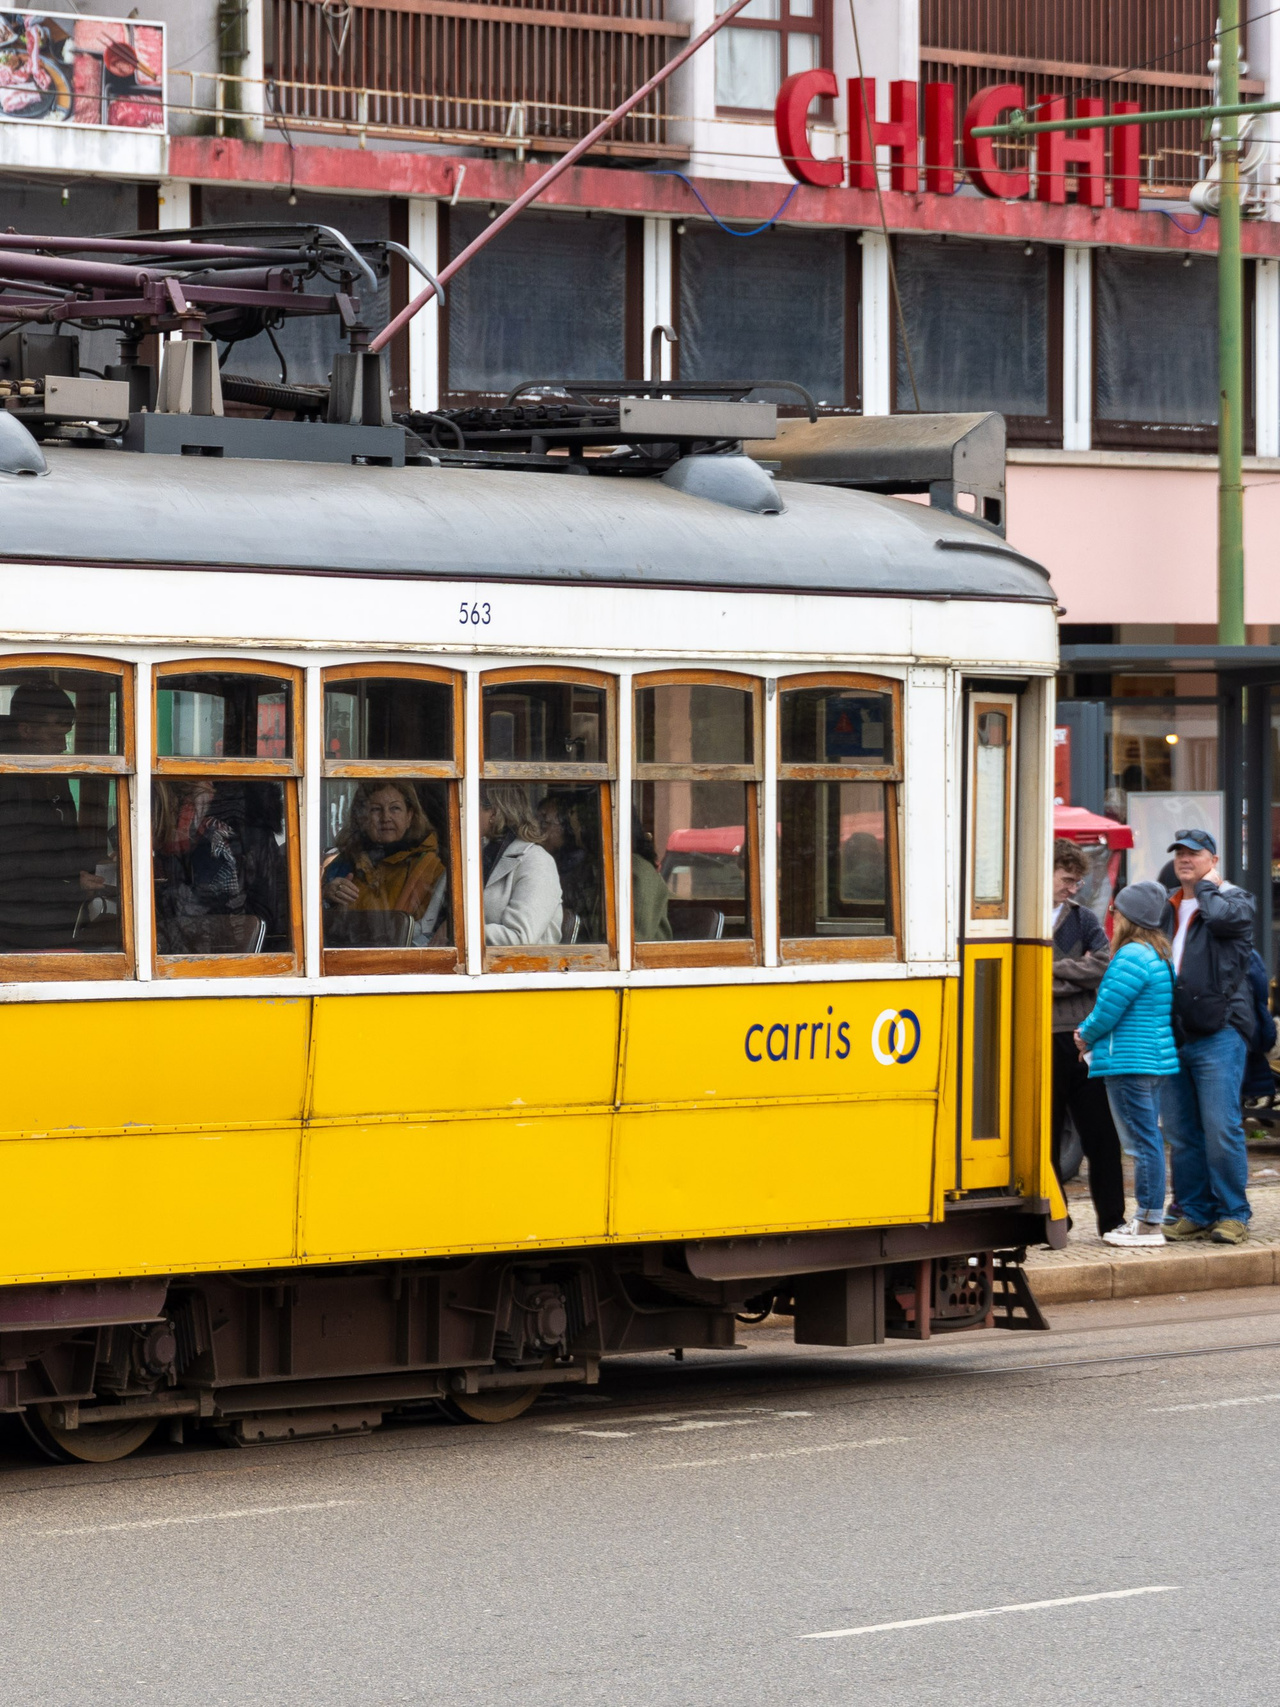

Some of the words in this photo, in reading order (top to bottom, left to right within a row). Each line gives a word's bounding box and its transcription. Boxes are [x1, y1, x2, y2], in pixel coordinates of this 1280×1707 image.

[774, 68, 1140, 211] CHICHI
[459, 602, 491, 625] 563
[745, 1005, 851, 1063] carris
